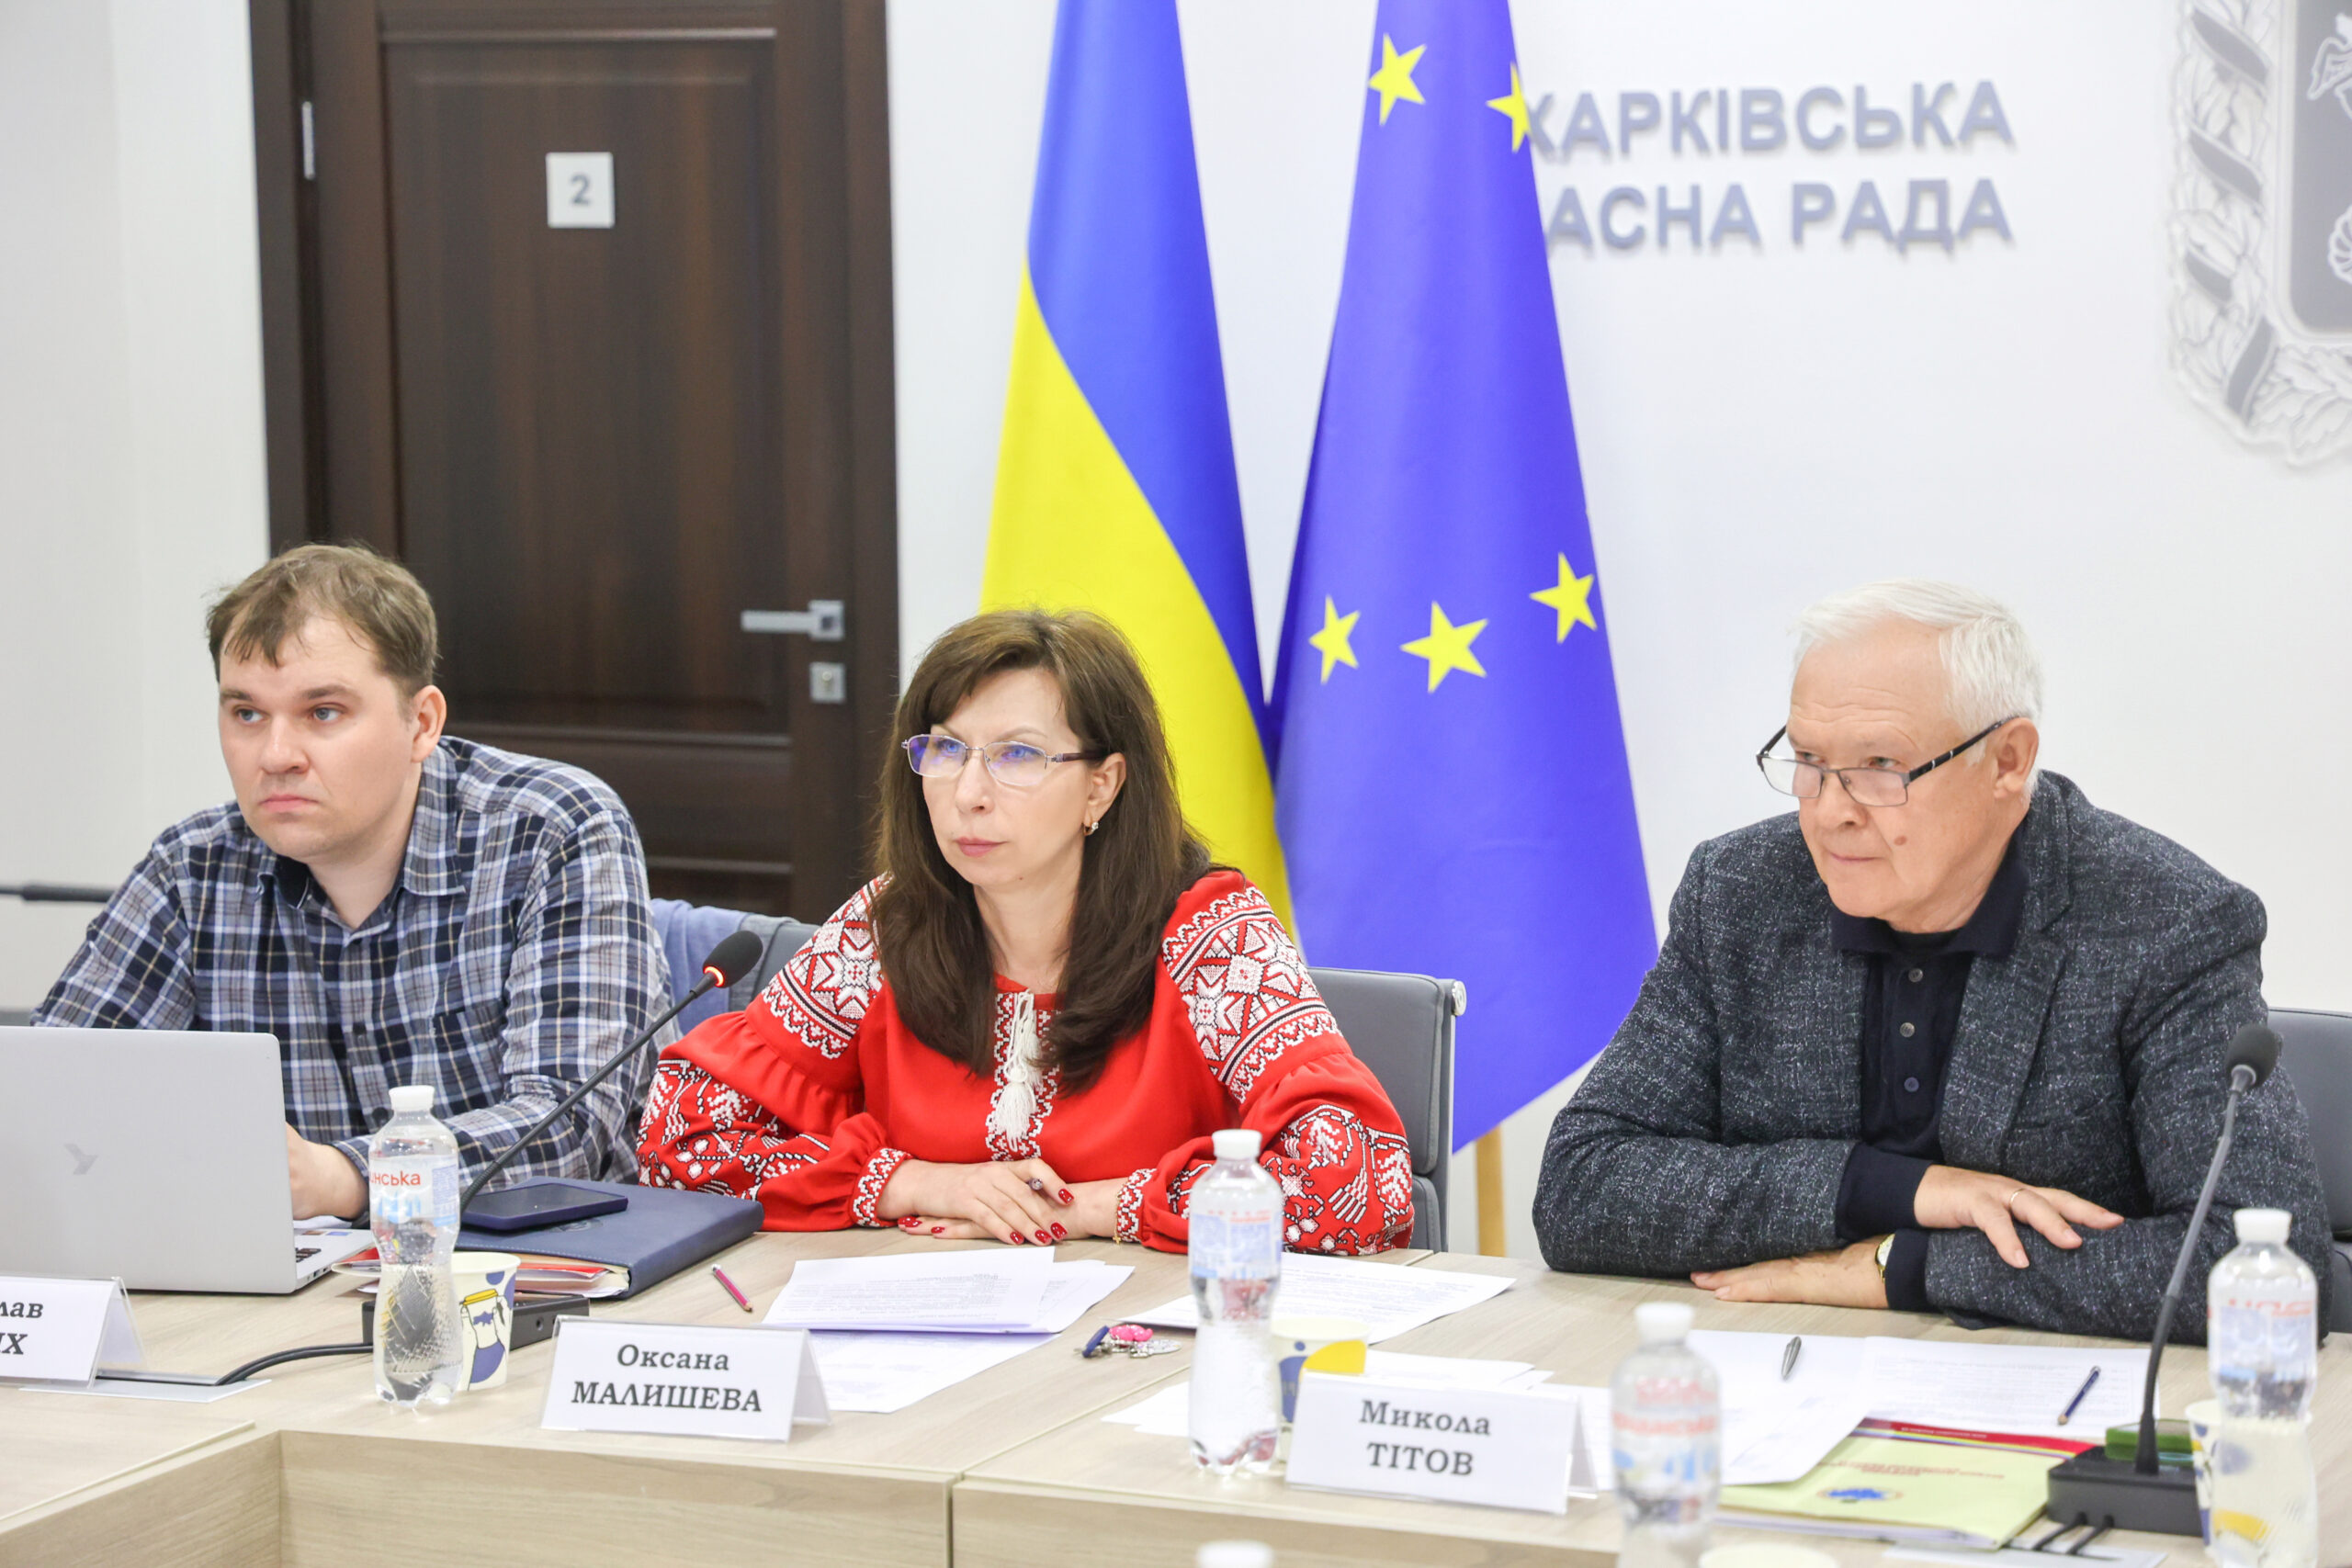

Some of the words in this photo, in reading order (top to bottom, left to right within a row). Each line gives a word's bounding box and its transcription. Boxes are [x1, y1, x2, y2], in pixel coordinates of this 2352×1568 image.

[1530, 81, 2015, 156] ХАРКІВСЬКА
[570, 174, 592, 205] 2
[1792, 178, 2014, 253] РАДА
[617, 1344, 729, 1371] Оксана
[571, 1381, 762, 1412] МАЛИШЕВА
[1360, 1399, 1491, 1436] Микола
[1366, 1441, 1474, 1476] ТІТОВ
